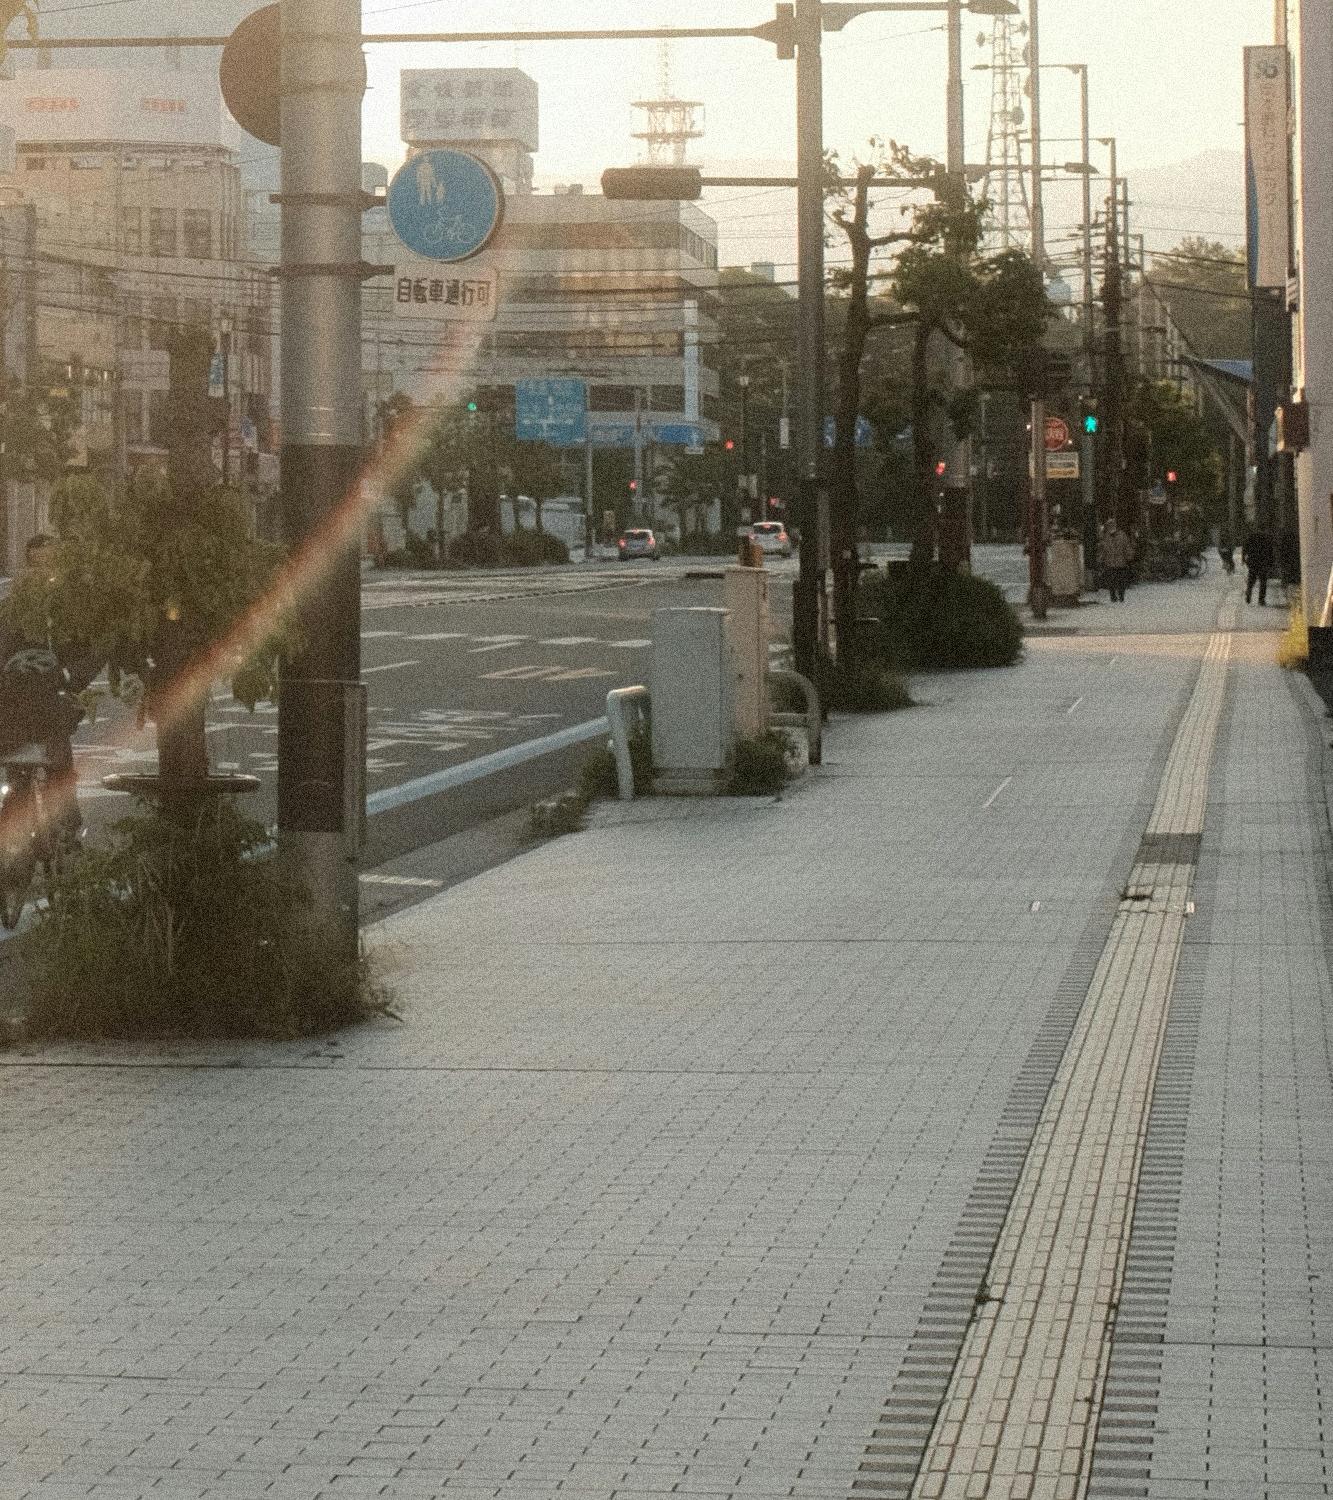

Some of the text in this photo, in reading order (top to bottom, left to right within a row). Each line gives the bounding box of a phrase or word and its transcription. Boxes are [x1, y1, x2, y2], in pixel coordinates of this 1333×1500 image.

[397, 278, 491, 306] 自転車通行可
